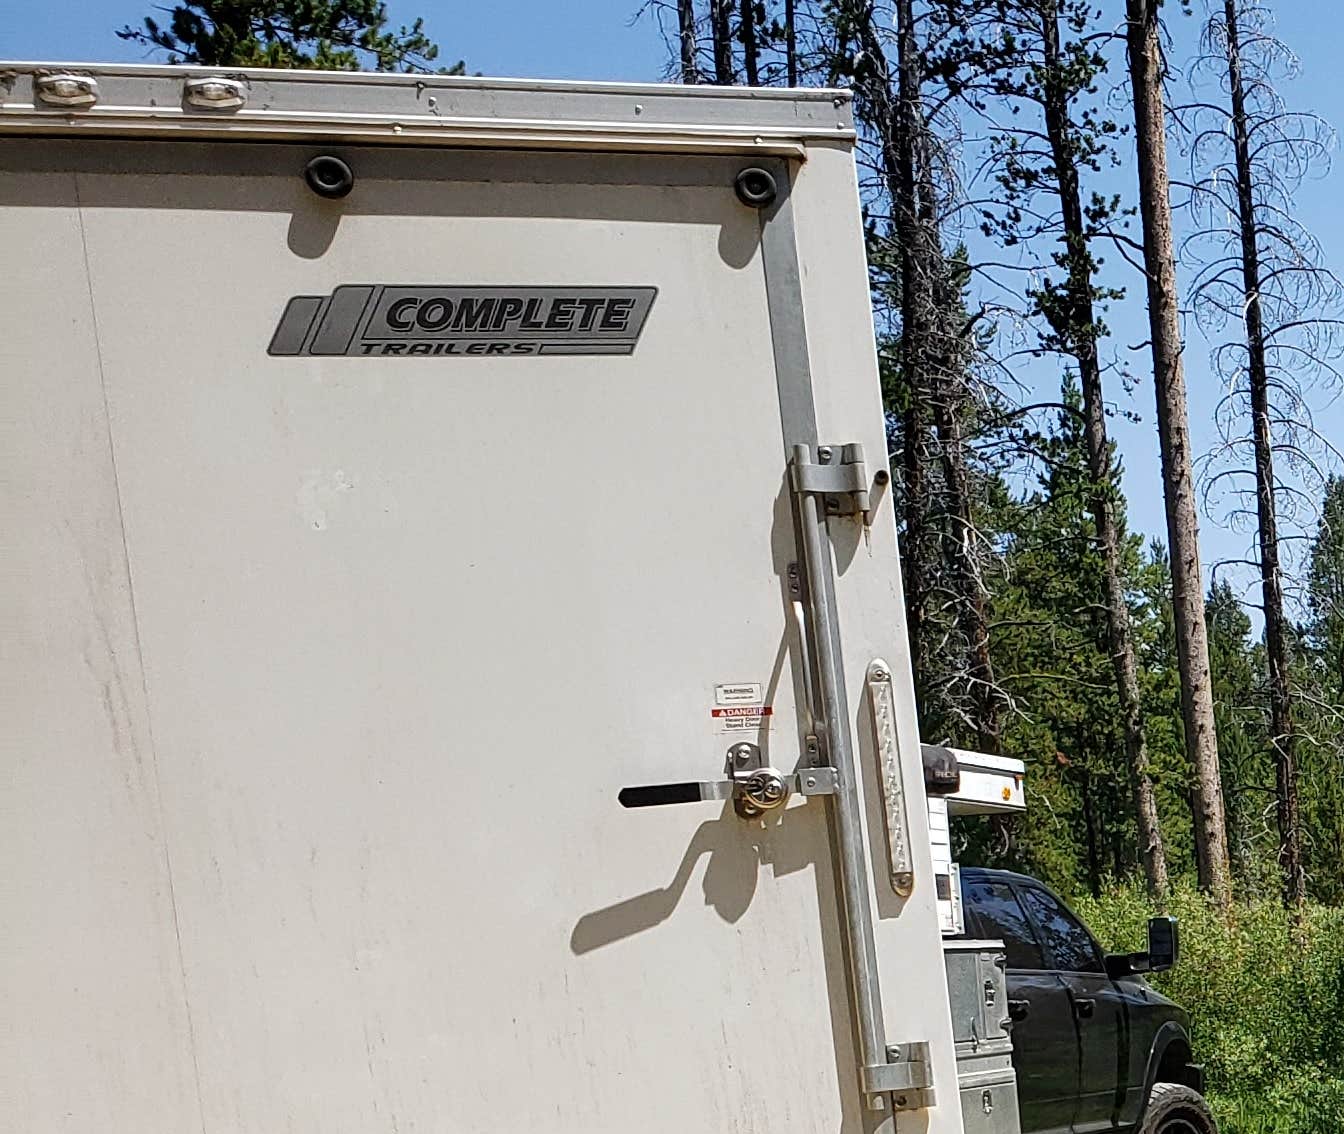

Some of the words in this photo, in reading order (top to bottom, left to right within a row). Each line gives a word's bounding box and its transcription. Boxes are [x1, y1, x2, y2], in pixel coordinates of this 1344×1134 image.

[385, 296, 637, 333] COMPLETE
[360, 342, 538, 355] TRAILERS
[727, 708, 766, 717] DANGER
